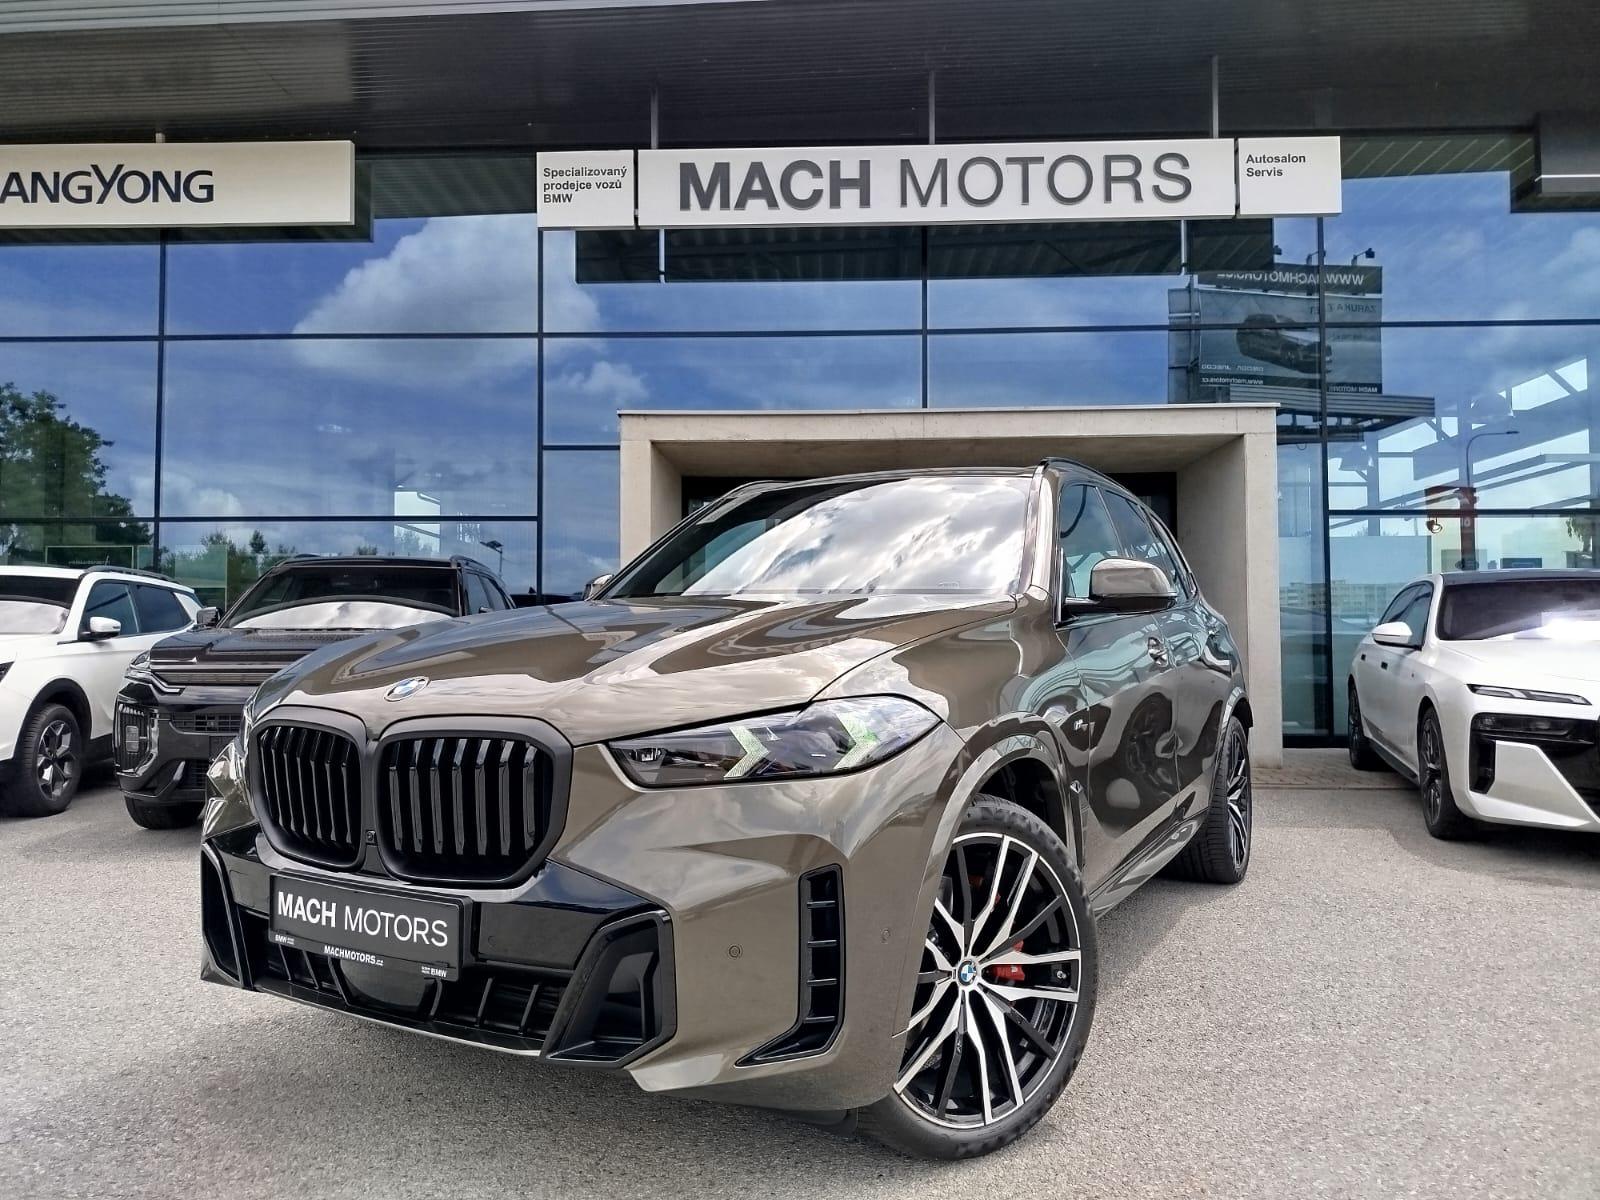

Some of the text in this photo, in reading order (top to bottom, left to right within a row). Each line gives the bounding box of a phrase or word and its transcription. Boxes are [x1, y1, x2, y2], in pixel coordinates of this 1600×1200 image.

[1245, 153, 1306, 164] Autosalon
[543, 166, 628, 179] Specializovaný
[1246, 167, 1283, 177] Servis
[0, 164, 214, 205] ANGYONG
[543, 180, 622, 192] prodejce vozů
[679, 152, 1193, 212] MACH MOTORS
[543, 193, 573, 204] BMW
[277, 891, 448, 947] MACH MOTORS
